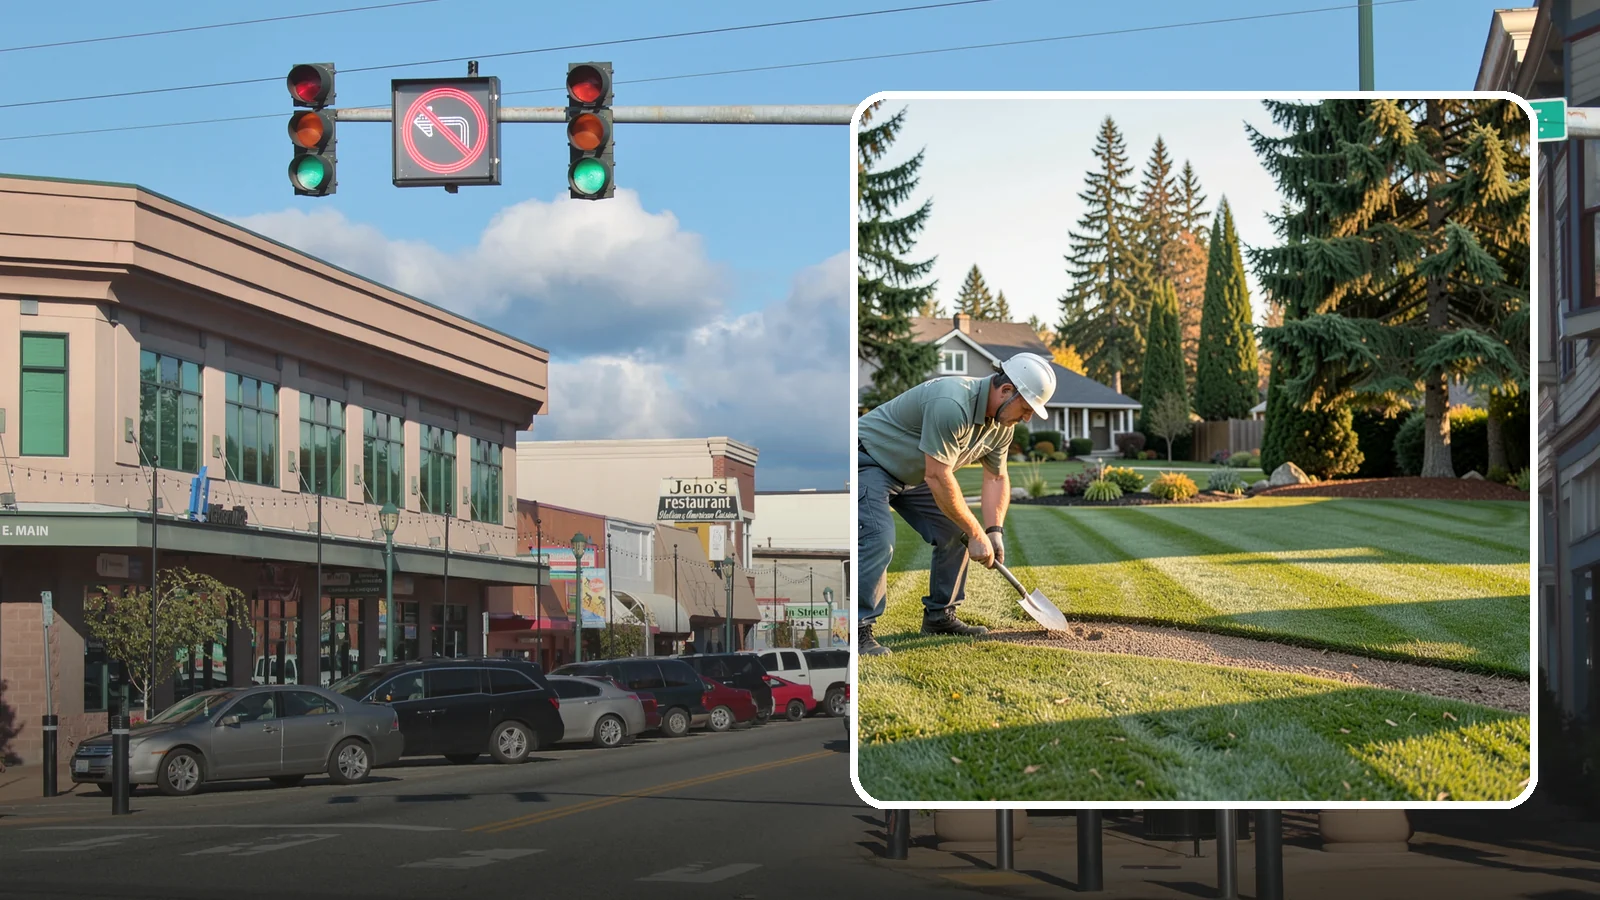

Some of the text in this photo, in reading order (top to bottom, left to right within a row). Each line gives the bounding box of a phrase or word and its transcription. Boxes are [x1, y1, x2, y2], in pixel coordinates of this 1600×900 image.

[670, 480, 727, 494] Jeno's
[665, 496, 731, 509] restaurant
[659, 510, 681, 519] Italian
[686, 510, 714, 519] American
[715, 510, 737, 519] Cuisine
[2, 525, 49, 536] E. MAIN
[797, 608, 828, 616] Street
